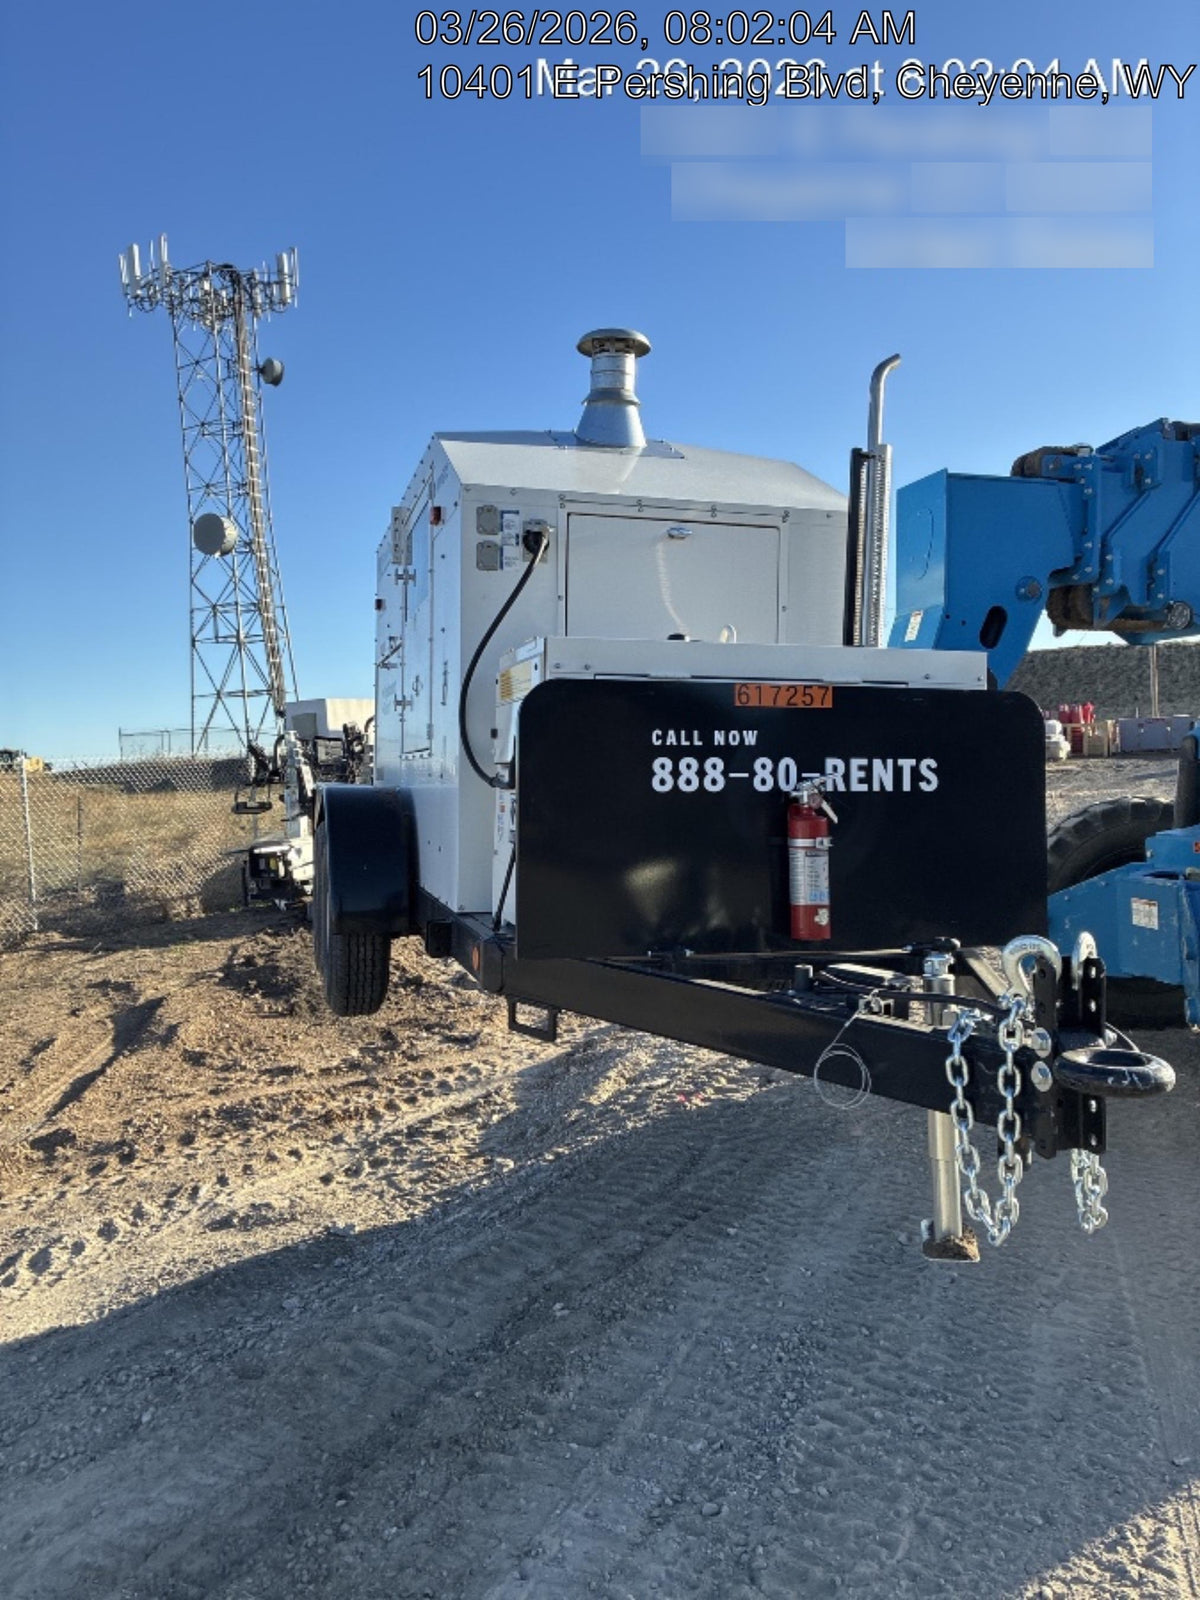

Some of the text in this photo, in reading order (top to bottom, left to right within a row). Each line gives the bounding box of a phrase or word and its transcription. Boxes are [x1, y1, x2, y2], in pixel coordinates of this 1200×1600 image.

[737, 683, 830, 706] 617257
[651, 729, 758, 746] CALL NOW
[651, 756, 939, 793] 888-80-RENTS
